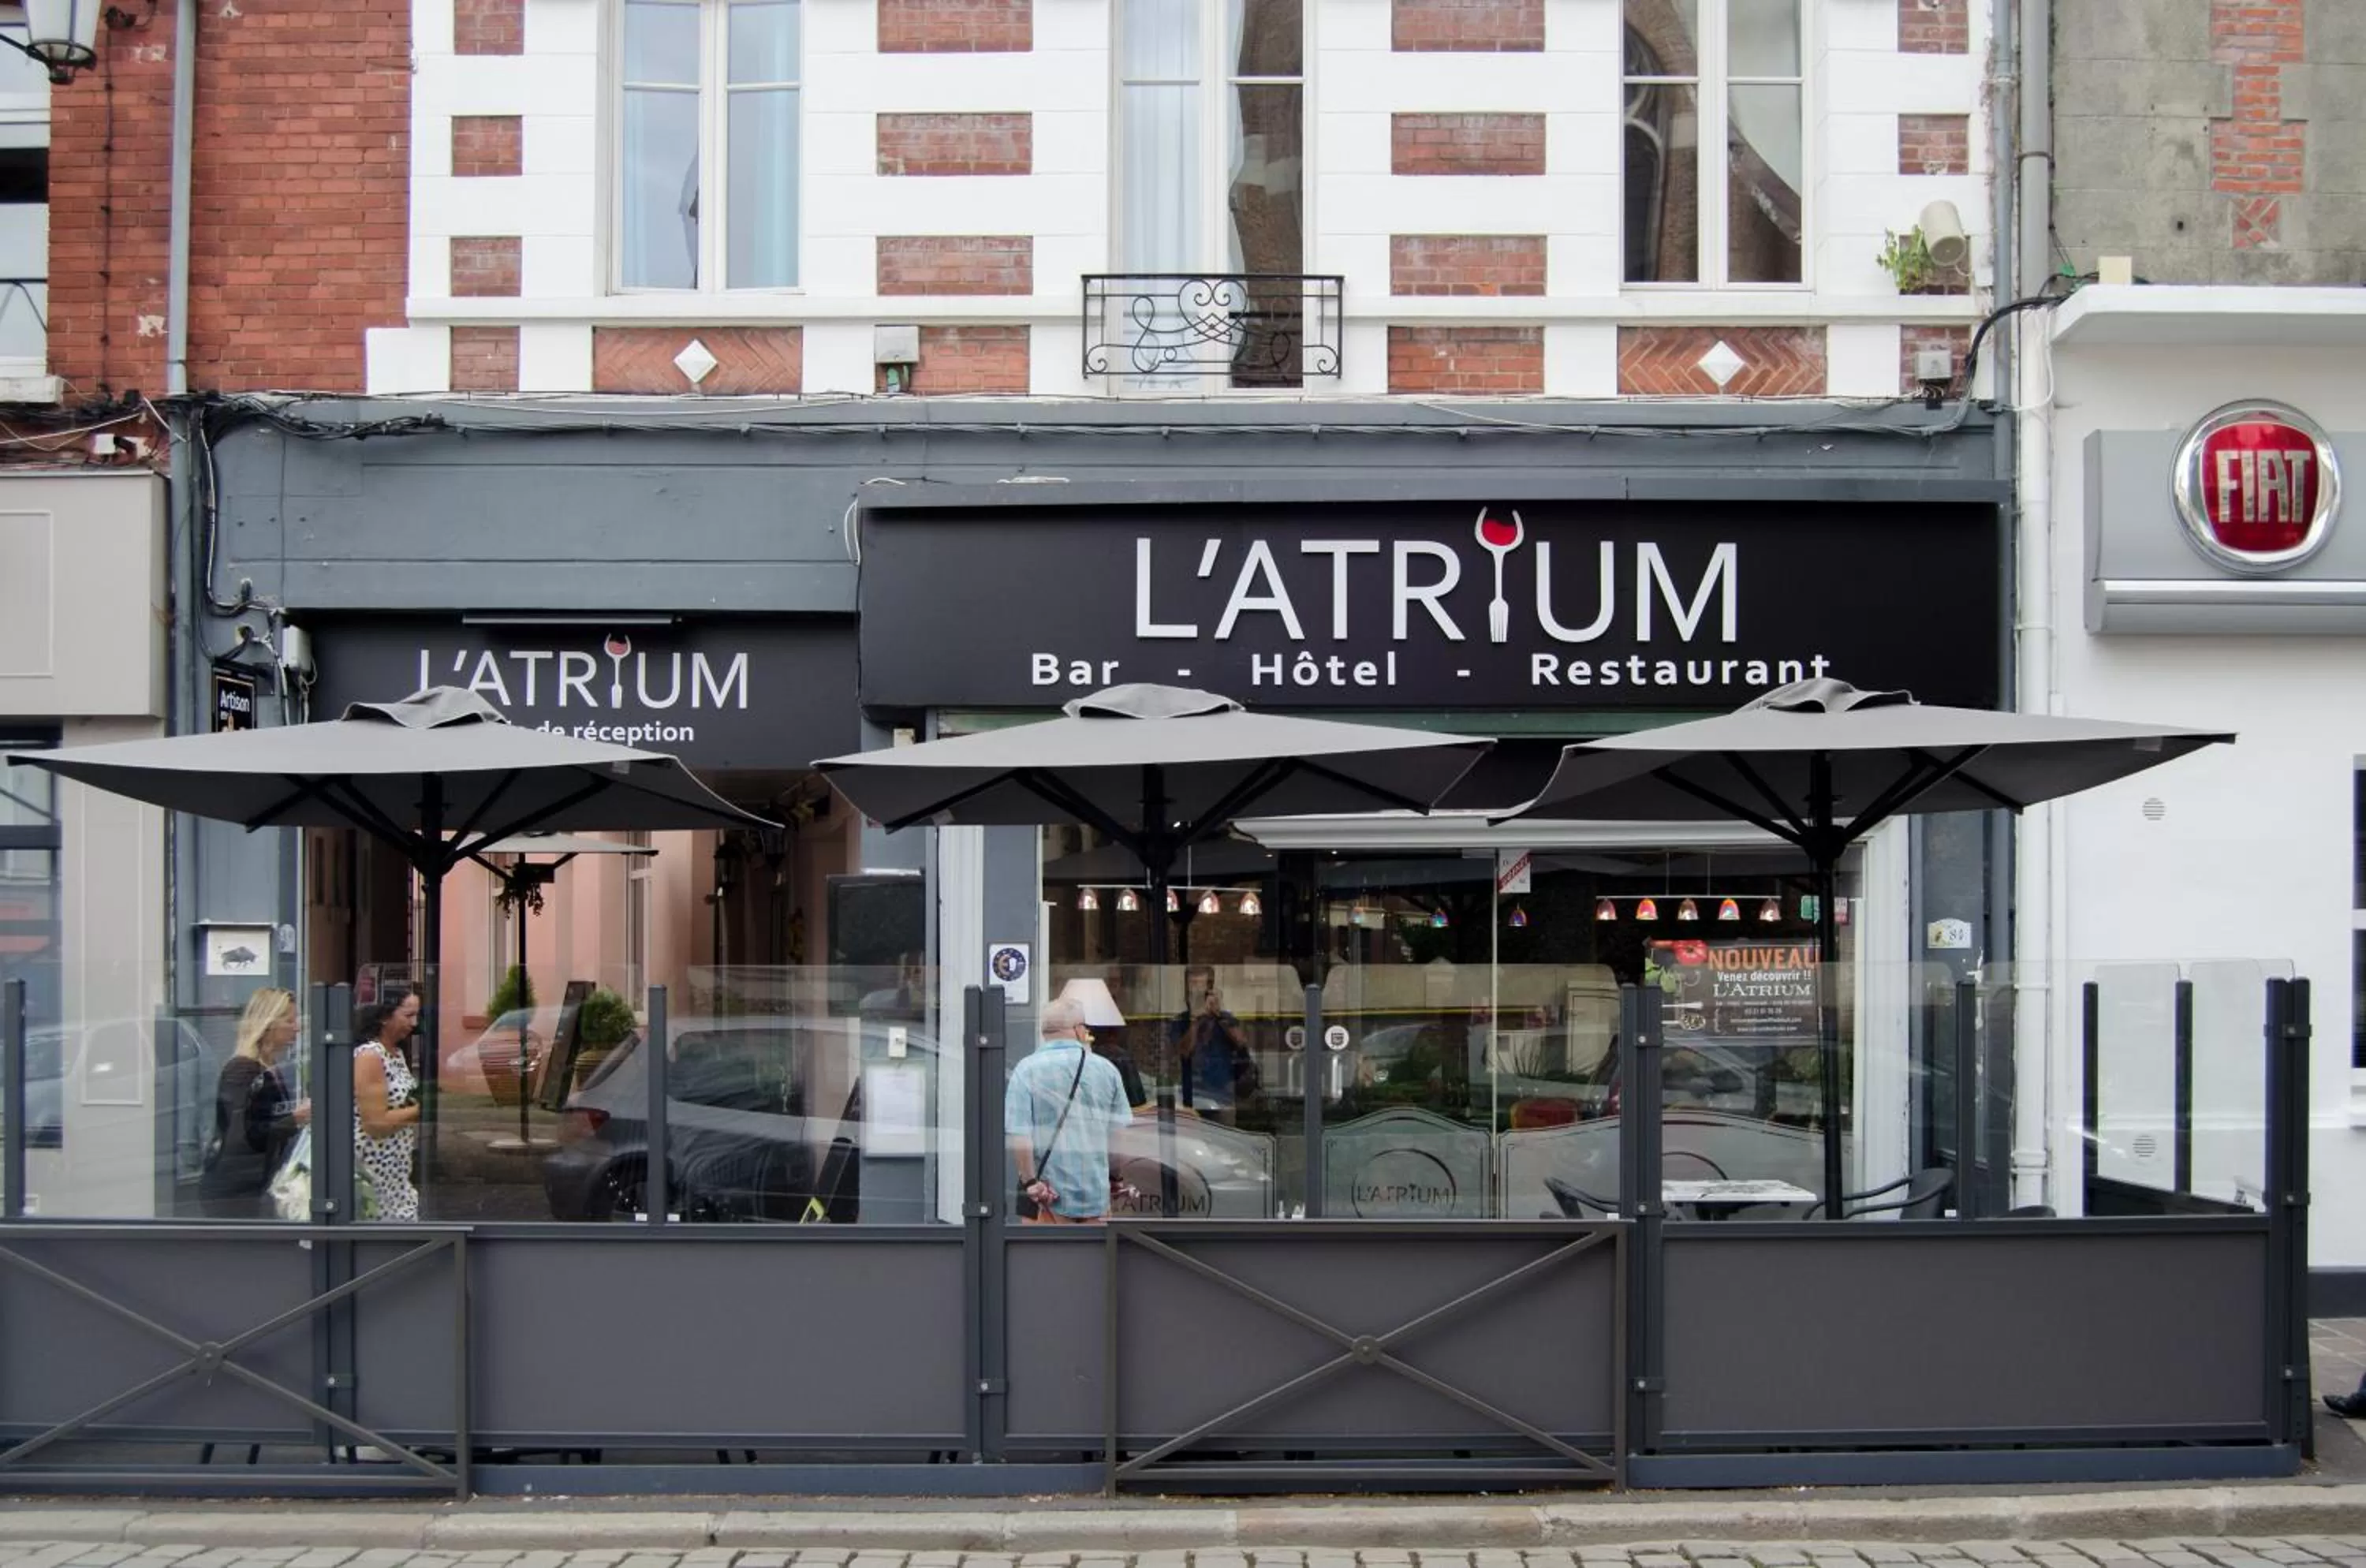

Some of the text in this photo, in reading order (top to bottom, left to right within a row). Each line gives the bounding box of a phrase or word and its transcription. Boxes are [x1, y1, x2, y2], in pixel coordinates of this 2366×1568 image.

[2215, 449, 2312, 524] FIAT
[1136, 506, 1738, 643] L'ATRIUM
[1032, 653, 1120, 685] Bar
[1251, 651, 1397, 685] Hôtel
[1531, 654, 1830, 685] Restaurant
[573, 720, 695, 745] réception
[1717, 971, 1748, 982] Venez
[1750, 970, 1801, 982] découvrir
[1712, 983, 1812, 997] L'ATRIUM
[1110, 1193, 1206, 1212] L'ATRM
